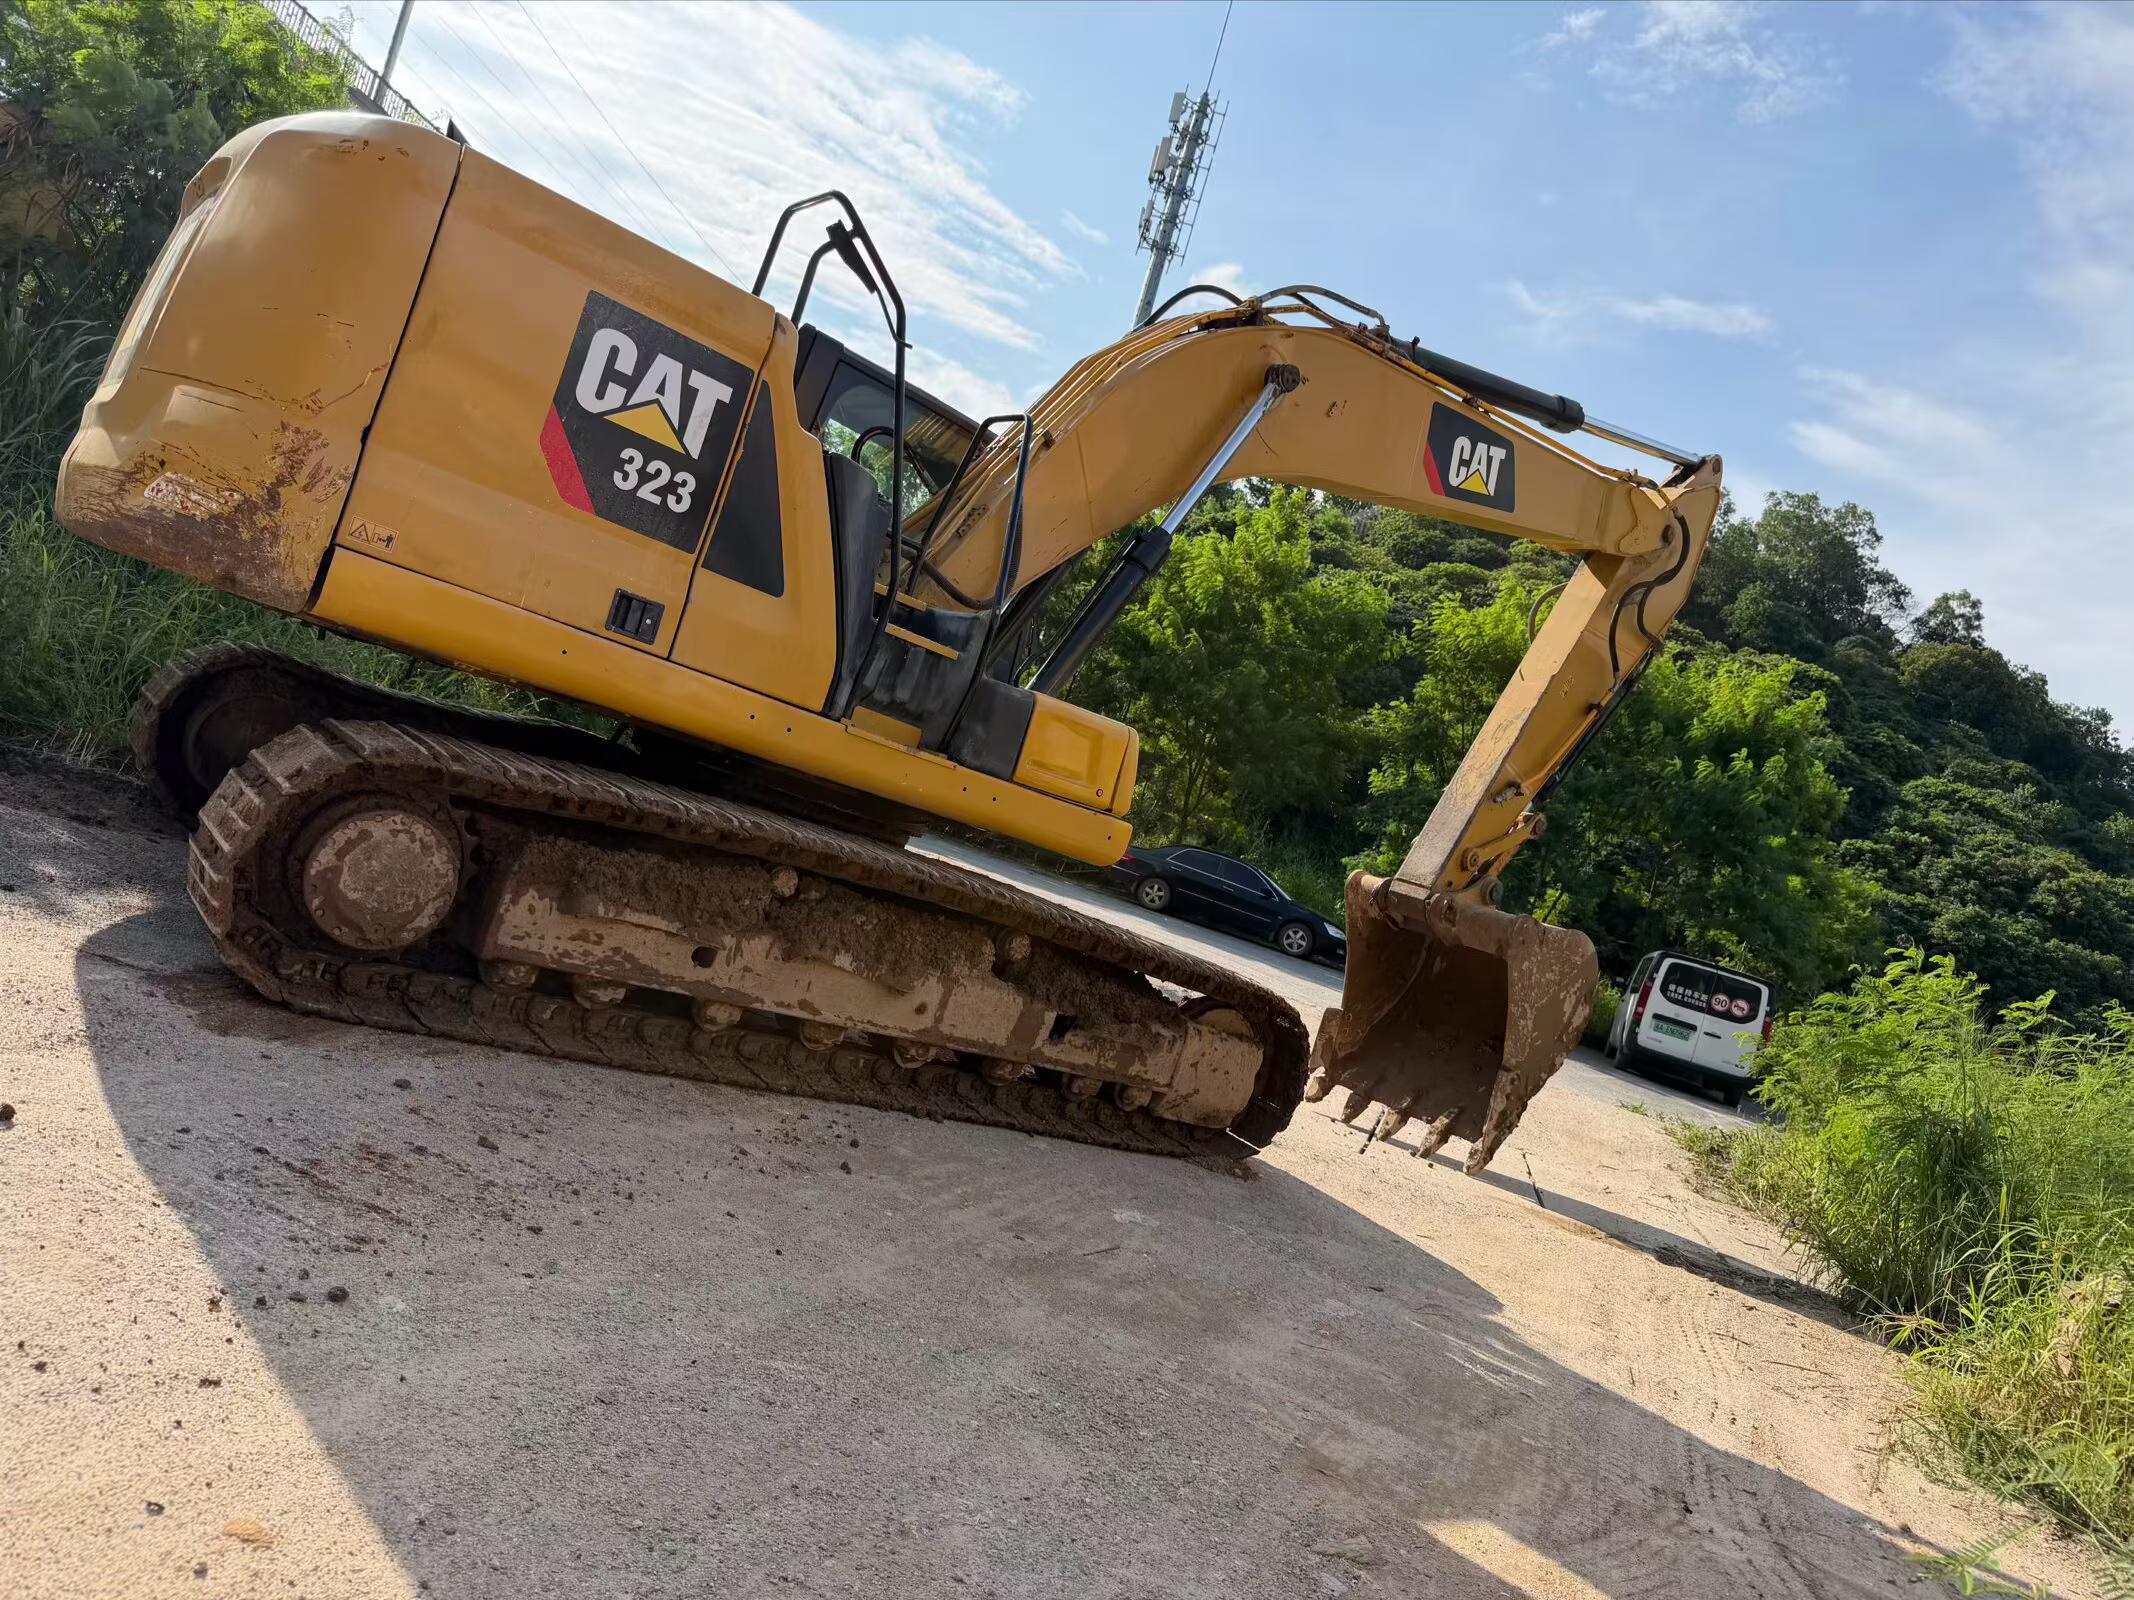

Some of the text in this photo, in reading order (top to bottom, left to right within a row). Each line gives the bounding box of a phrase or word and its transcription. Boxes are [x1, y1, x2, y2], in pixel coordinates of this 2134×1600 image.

[575, 328, 733, 460] CAT
[613, 448, 697, 513] 323
[1448, 436, 1507, 497] CAT
[1713, 997, 1728, 1008] 90
